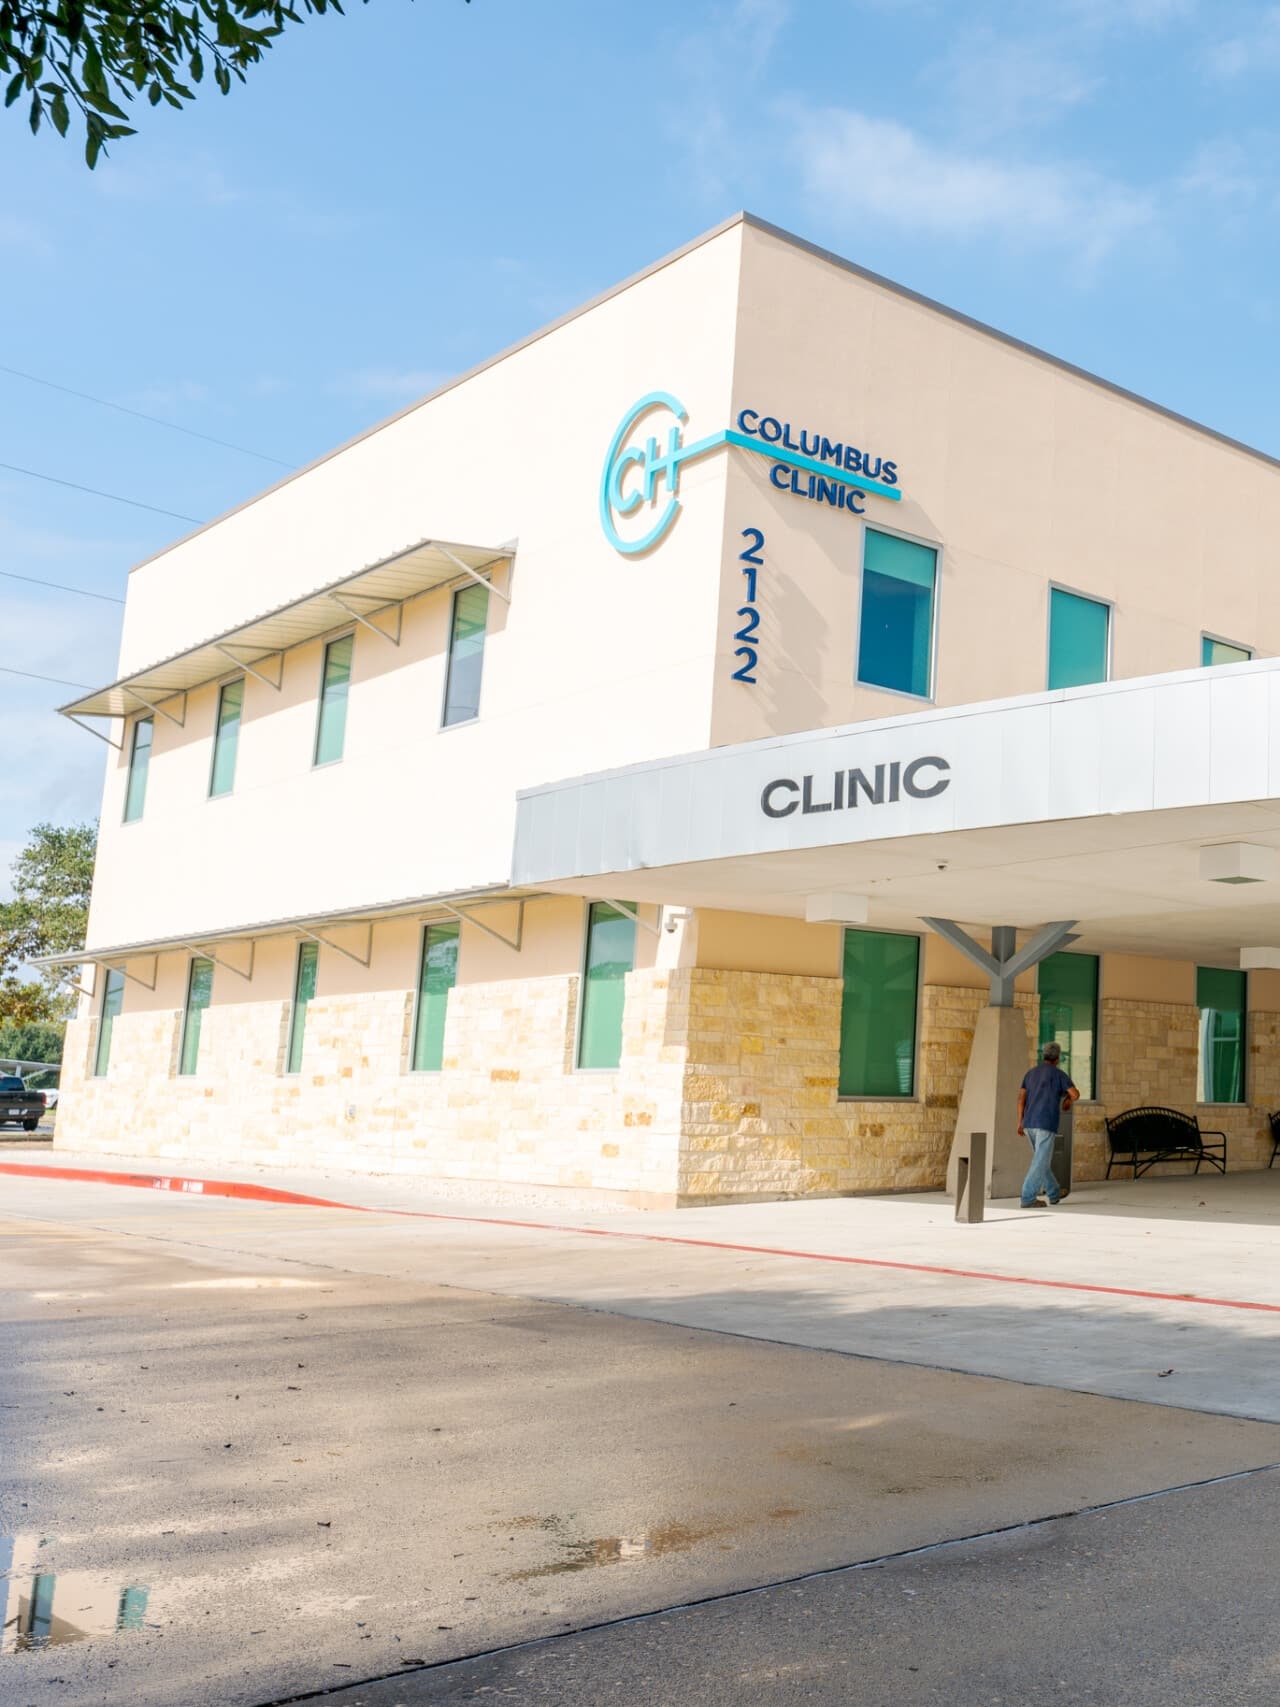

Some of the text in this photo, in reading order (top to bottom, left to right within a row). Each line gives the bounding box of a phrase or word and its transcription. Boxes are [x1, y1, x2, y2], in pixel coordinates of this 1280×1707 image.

[737, 408, 899, 485] COLUMBUS
[769, 463, 867, 515] CLINIC
[731, 527, 765, 684] 2122
[760, 756, 951, 818] CLINIC
